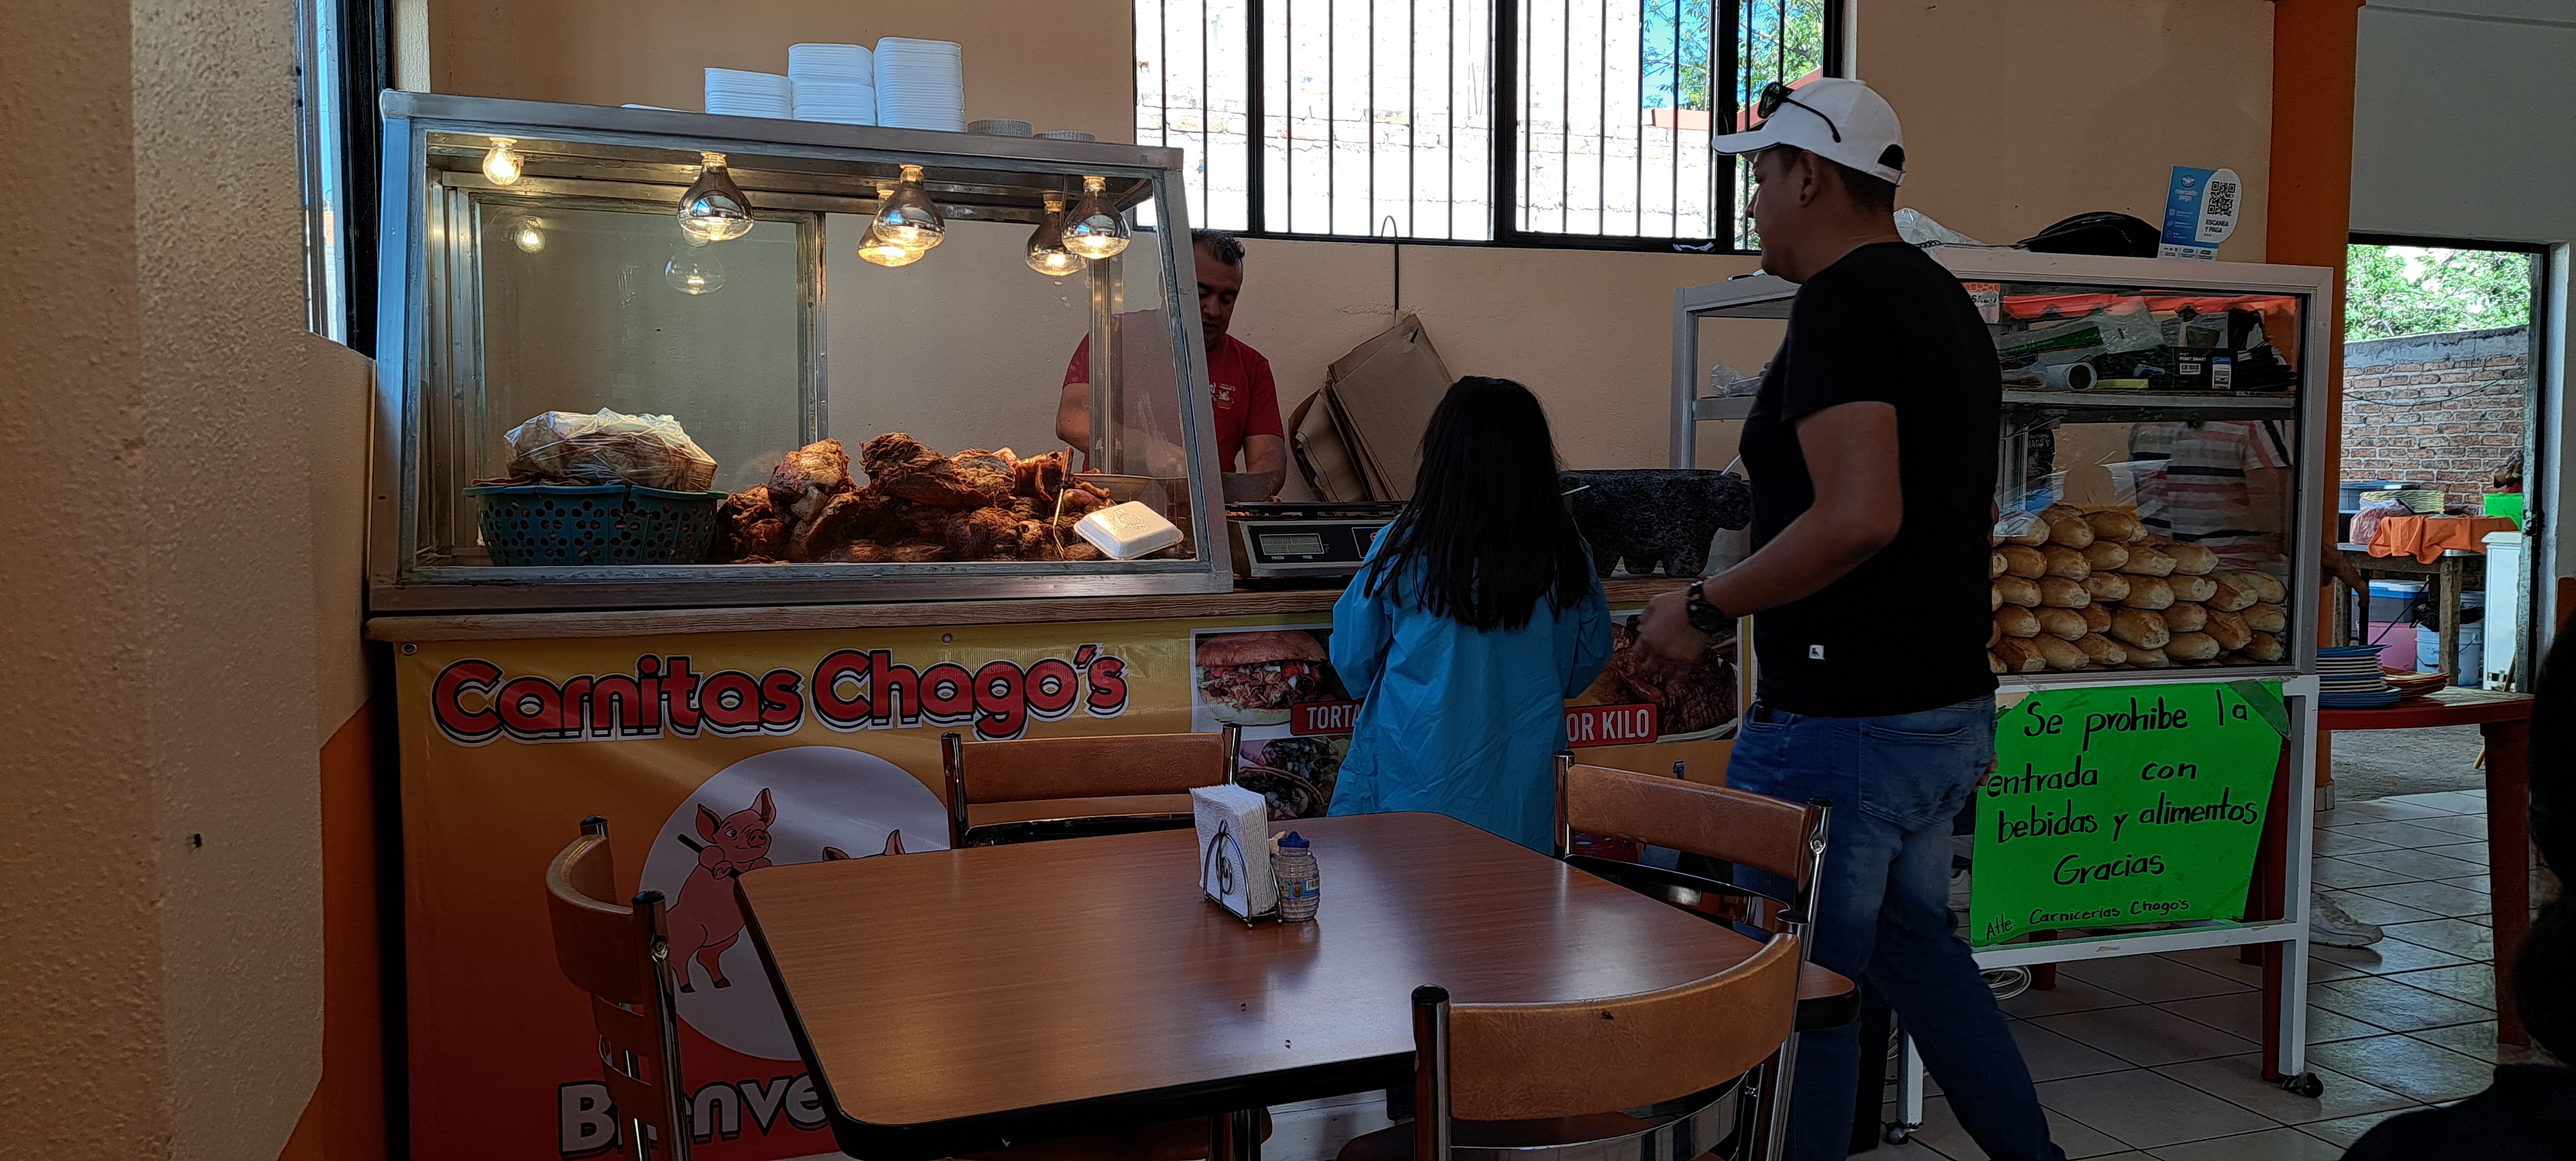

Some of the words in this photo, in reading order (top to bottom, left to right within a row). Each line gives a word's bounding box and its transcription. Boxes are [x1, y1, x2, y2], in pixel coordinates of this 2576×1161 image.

[431, 653, 804, 745] Carnitas
[812, 644, 1129, 741] Chago's
[1306, 704, 1360, 730] TORTA
[1566, 713, 1595, 742] OR
[1602, 709, 1650, 740] KILO
[2023, 700, 2065, 737] Se
[2083, 696, 2188, 752] prohibe
[2216, 689, 2247, 726] la
[1987, 755, 2098, 797] entrada
[2141, 762, 2197, 780] con
[1998, 799, 2098, 843] bebidas
[2112, 812, 2129, 842] y
[2139, 787, 2257, 825] alimentos
[2053, 853, 2165, 885] Gracias
[2029, 908, 2120, 925] Carnicerias
[557, 1073, 830, 1159] Bnve
